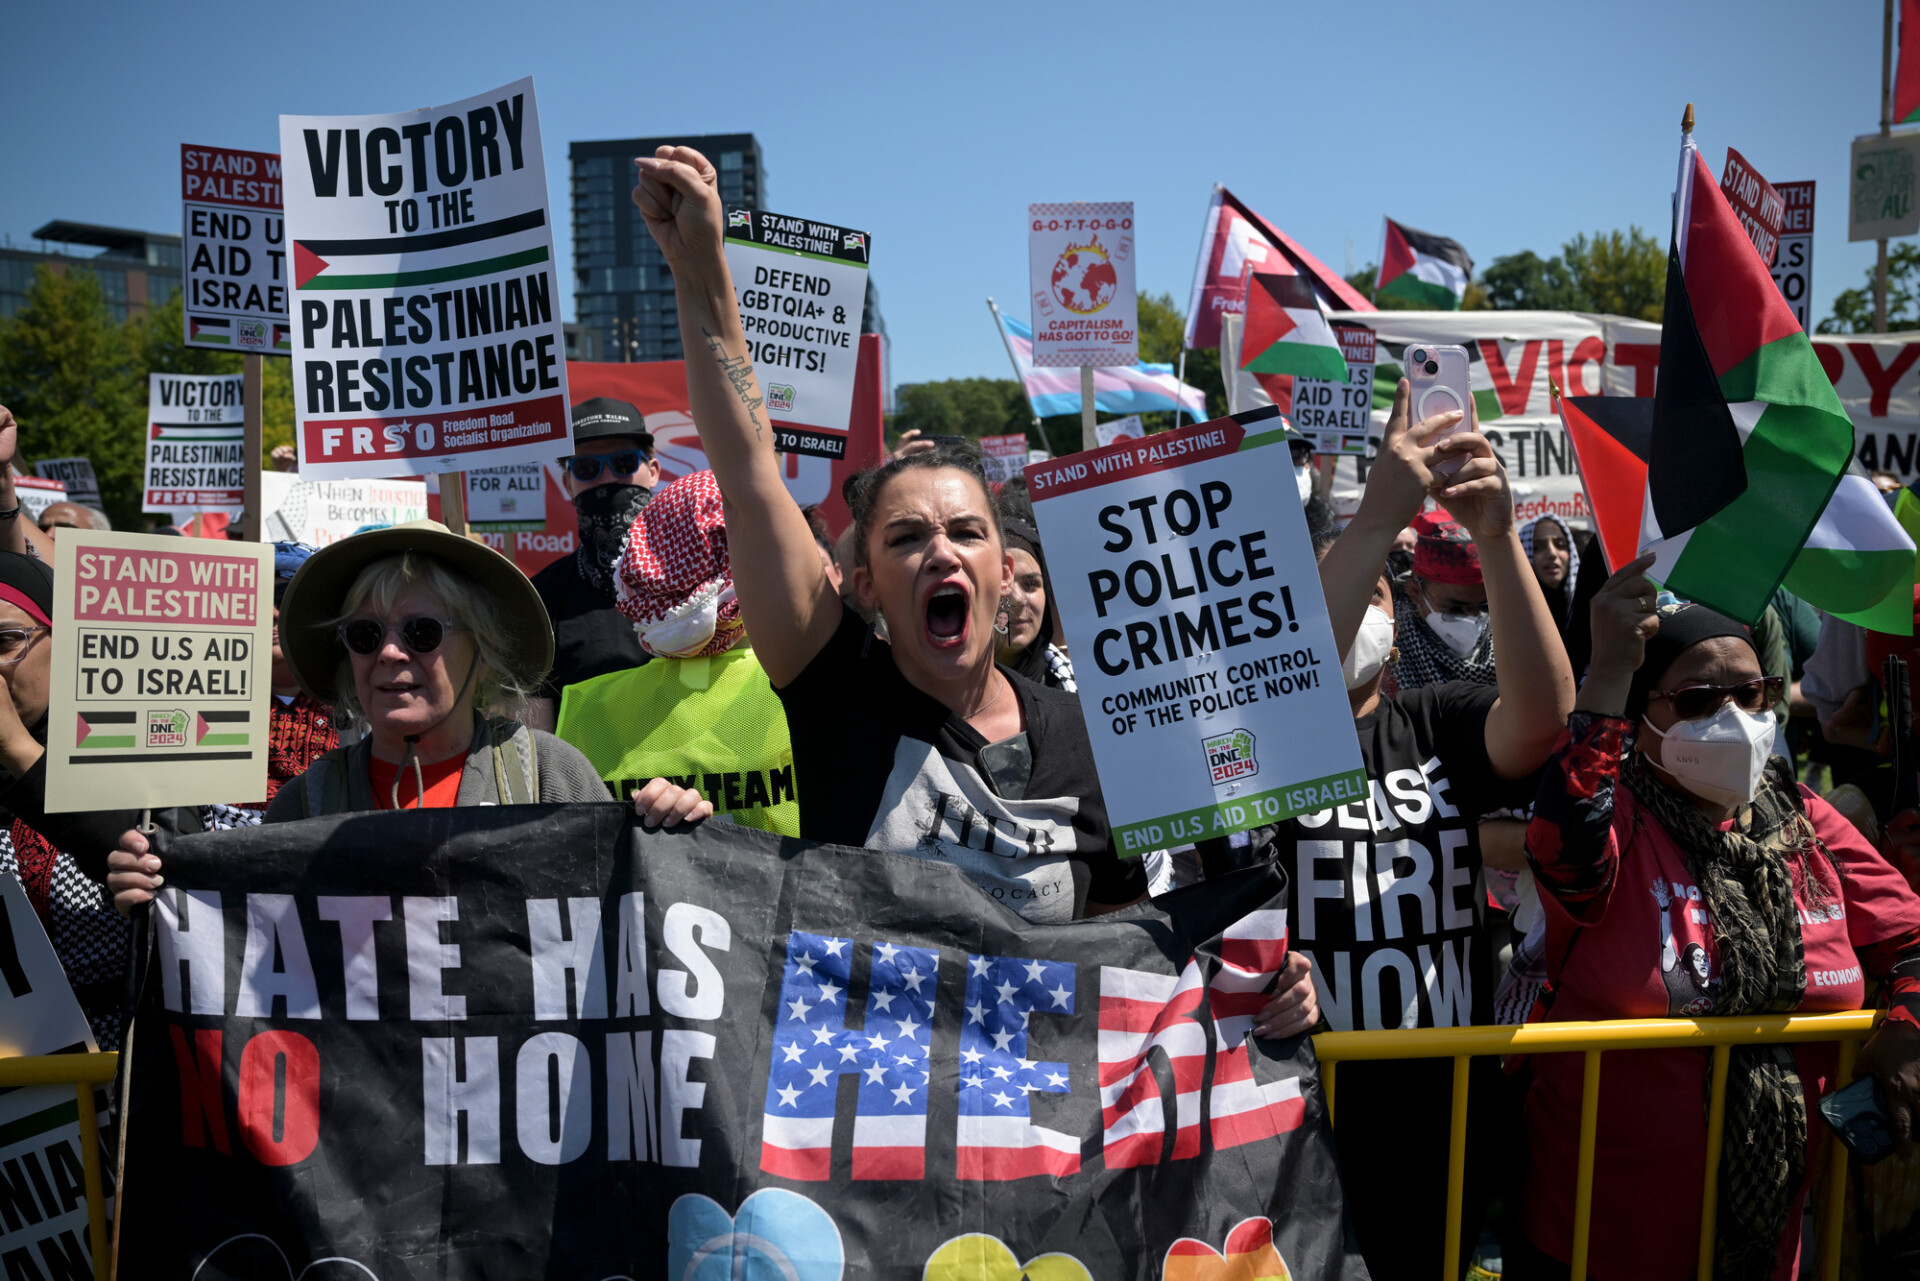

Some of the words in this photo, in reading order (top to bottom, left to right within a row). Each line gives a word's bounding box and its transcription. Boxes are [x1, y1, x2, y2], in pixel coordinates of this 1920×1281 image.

[303, 93, 524, 197] VICTORY
[184, 150, 256, 176] STAND
[186, 174, 283, 205] PALESTI
[1724, 159, 1760, 209] STAND
[1760, 189, 1783, 232] WITH
[1777, 186, 1812, 206] ITH
[384, 199, 419, 234] TO
[427, 188, 475, 229] THE
[191, 210, 251, 241] END
[761, 214, 804, 234] STAND
[808, 223, 839, 241] WITH
[764, 230, 834, 255] PALESTINE!
[191, 243, 251, 276] AID
[266, 250, 286, 280] T
[755, 266, 831, 297] DEFEND
[193, 278, 290, 314] ISRAE
[1211, 296, 1247, 311] Free
[301, 271, 552, 349] PALESTINIAN
[832, 305, 846, 325] &
[1038, 331, 1063, 341] HAS
[1065, 331, 1092, 341] GOT
[1094, 331, 1109, 340] TO
[1111, 330, 1134, 340] GO!
[1048, 319, 1123, 330] CAPITALISM
[1343, 331, 1374, 345] WITH
[304, 334, 559, 413] RESISTANCE
[769, 399, 791, 409] 2024
[1296, 385, 1332, 406] AID
[1342, 388, 1368, 407] TO
[187, 409, 200, 421] TO
[204, 408, 223, 421] THE
[442, 415, 487, 433] Freedom
[489, 411, 515, 427] Road
[1296, 408, 1366, 429] ISRAEL!
[322, 421, 436, 456] FRSO
[443, 428, 489, 449] Socialist
[490, 420, 552, 444] Organization
[781, 433, 797, 446] TO
[800, 436, 843, 453] ISRAEL!
[1033, 465, 1088, 490] STAND
[1091, 452, 1134, 476] WITH
[1138, 429, 1227, 464] PALESTINE!
[317, 482, 362, 501] WHEN
[470, 477, 500, 491] FOR
[507, 477, 540, 491] ALL!
[328, 504, 389, 522] BECOMES
[1098, 480, 1233, 553] STOP
[1514, 495, 1572, 520] eedom
[518, 531, 574, 552] Road
[79, 553, 179, 584] STAND
[189, 561, 255, 588] WITH
[1087, 530, 1275, 618] POLICE
[80, 585, 256, 620] PALESTINE!
[1093, 585, 1300, 677] CRIMES!
[82, 634, 139, 660] END
[152, 636, 193, 661] U.S
[203, 638, 249, 662] AID
[81, 668, 124, 695] TO
[138, 668, 247, 695] ISRAEL!
[1101, 669, 1219, 716] COMMUNITY
[1227, 647, 1321, 685] CONTROL
[1111, 715, 1139, 736] OF
[1145, 704, 1184, 729] THE
[1191, 686, 1260, 719] POLICE
[1264, 670, 1321, 699] NOW!
[149, 734, 183, 744] 2024
[150, 723, 175, 734] DNC
[1207, 737, 1232, 748] MARCH
[1210, 748, 1241, 767] DNC
[1212, 759, 1255, 781] 2024
[703, 764, 794, 811] TEAM
[1122, 827, 1164, 851] END
[1176, 816, 1204, 838] U.S
[1212, 806, 1247, 832] AID
[1252, 797, 1281, 822] TO
[1286, 776, 1364, 811] ISRAEL!
[981, 880, 1062, 900] OCACY
[1297, 828, 1473, 942] FIRE
[155, 887, 467, 1022] HATE
[526, 891, 732, 1021] HAS
[1300, 935, 1473, 1031] NOW
[1813, 965, 1862, 987] ECONOMY
[760, 908, 1306, 1182] HERE
[169, 1023, 321, 1168] NO
[422, 1030, 717, 1168] HOME
